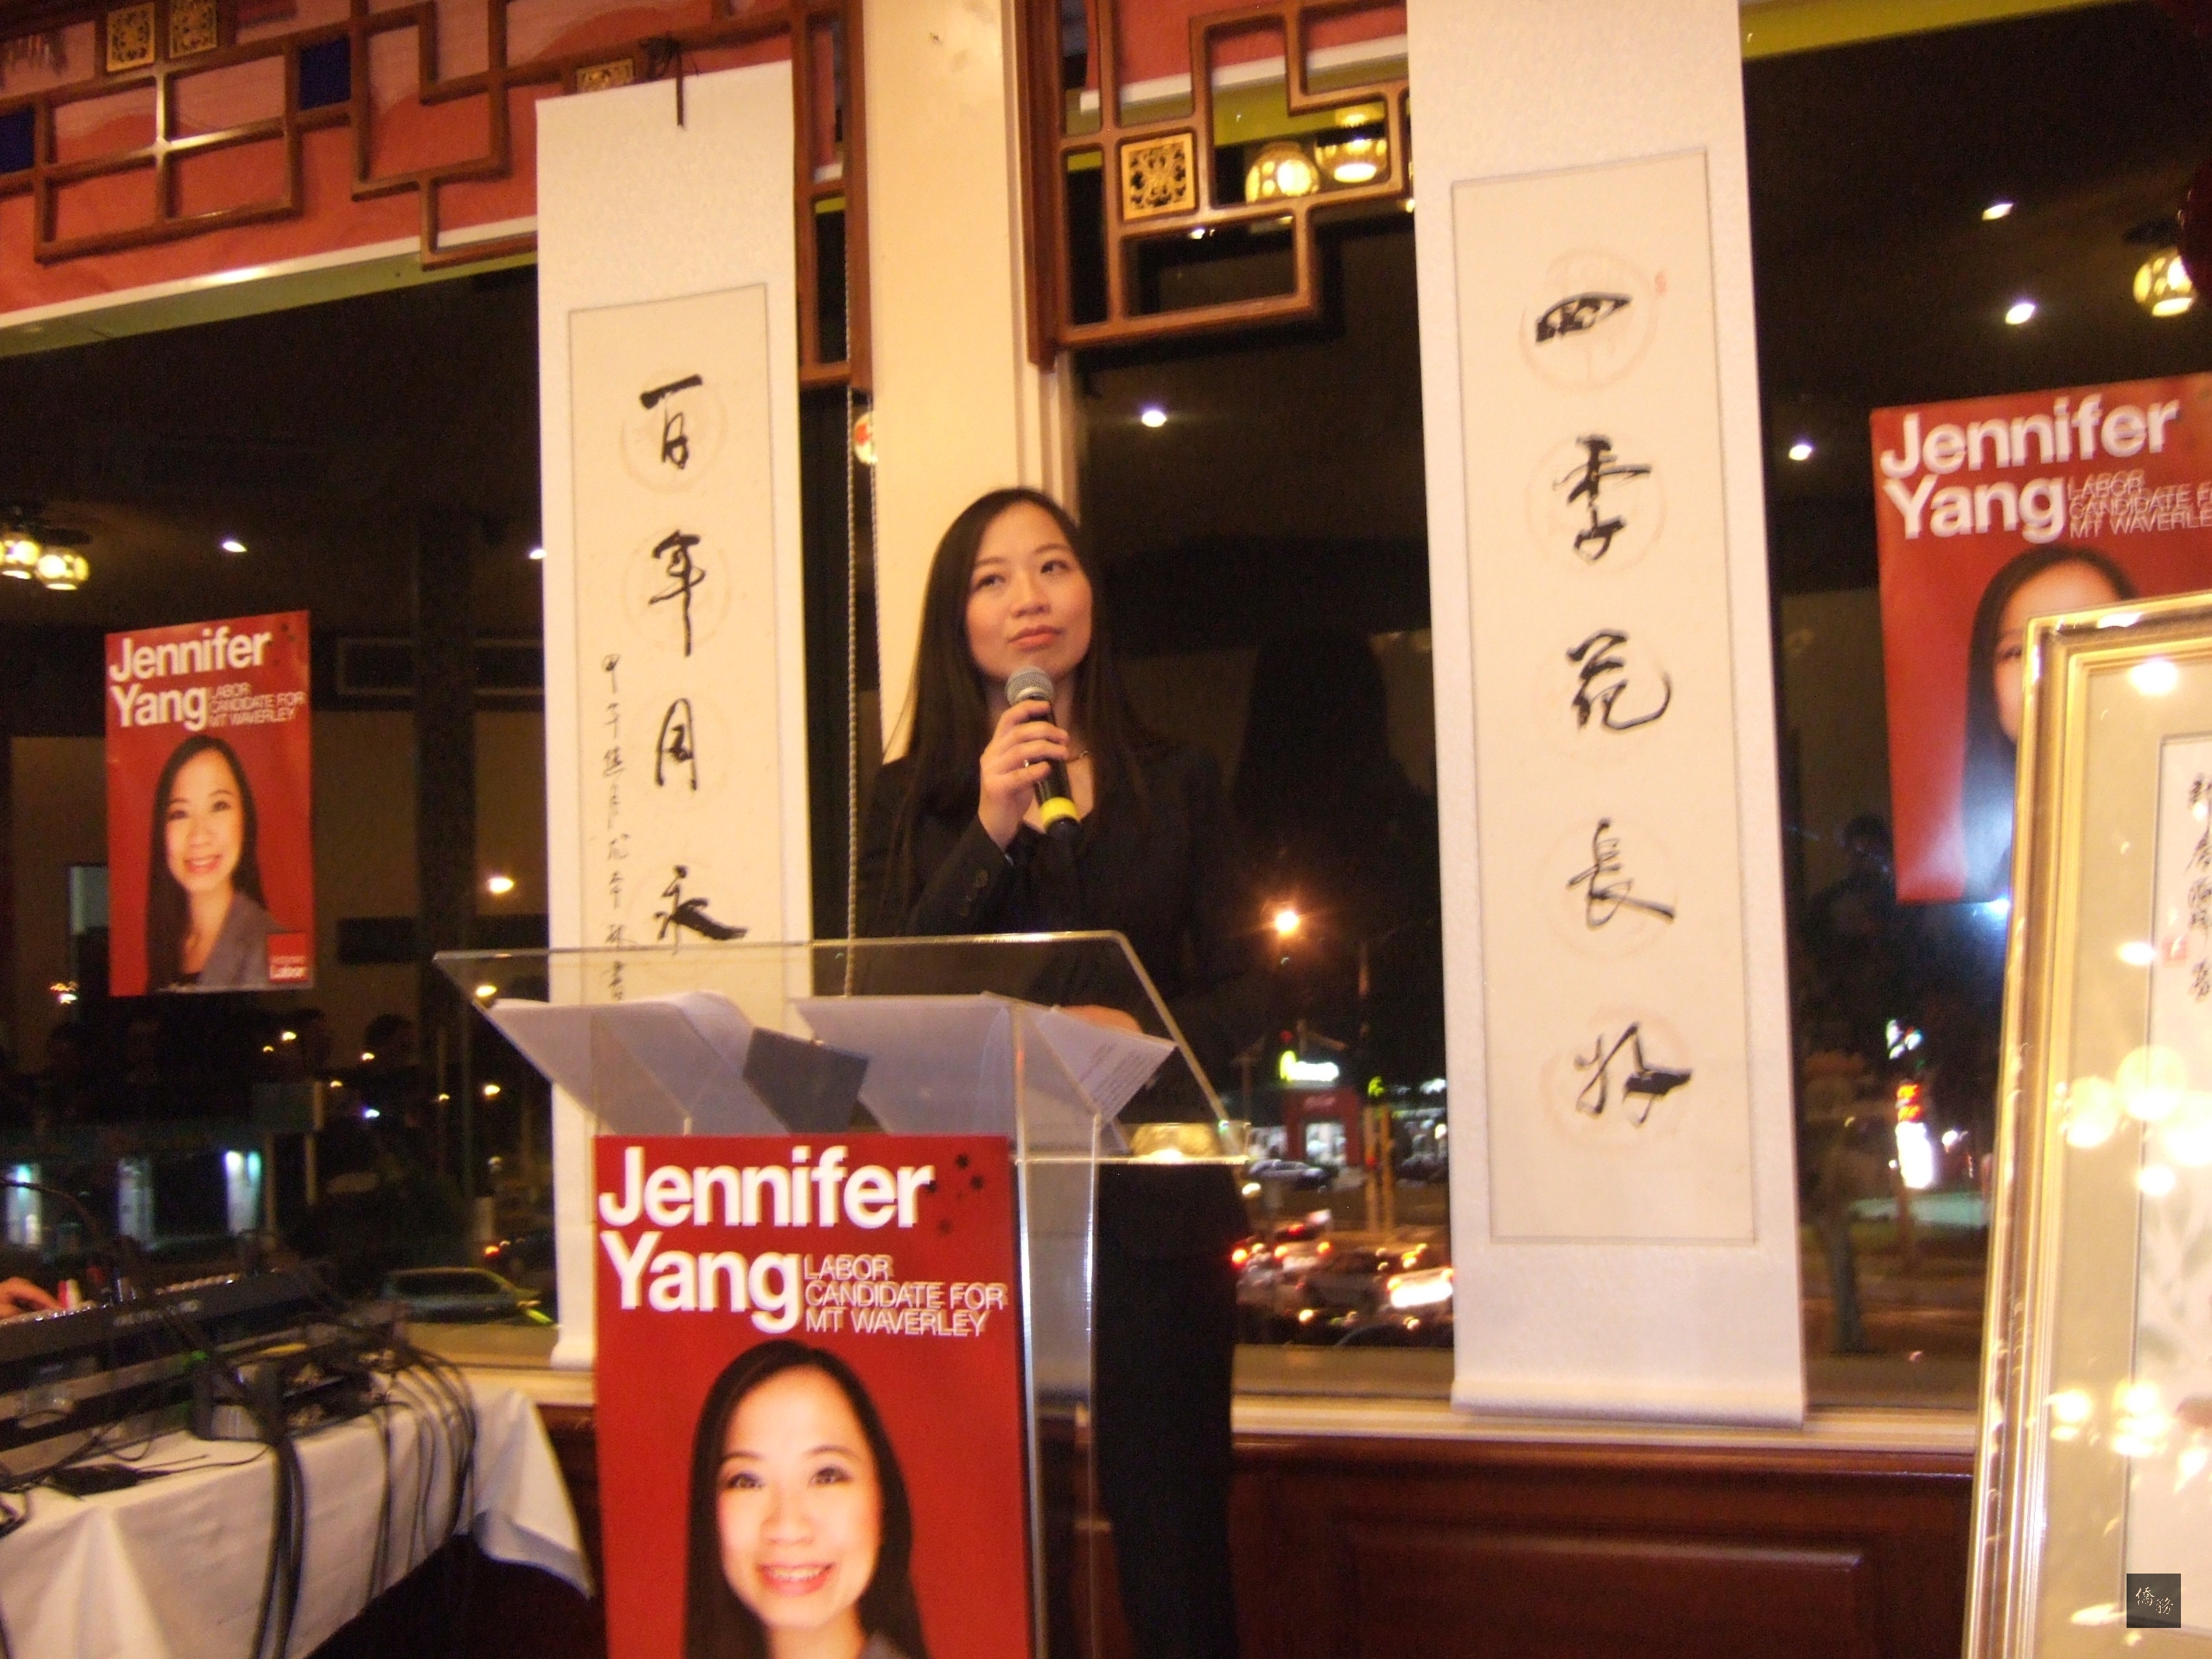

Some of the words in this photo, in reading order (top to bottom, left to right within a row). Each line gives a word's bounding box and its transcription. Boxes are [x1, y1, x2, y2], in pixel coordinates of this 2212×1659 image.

[1880, 393, 2180, 479] Jennifer
[2068, 469, 2145, 501] LABOR
[2070, 483, 2192, 520] CANDIDATE
[1883, 475, 2067, 544] Yang
[2109, 505, 2212, 535] WAVERLE
[110, 626, 272, 683] Jennifer
[111, 684, 208, 732] Yang
[277, 691, 308, 708] FOR
[598, 1146, 935, 1228] Jennifer
[600, 1231, 803, 1334] Yang
[804, 1254, 892, 1281] LABOR
[805, 1282, 945, 1309] CANDIDATE
[950, 1283, 1008, 1310] FOR
[806, 1308, 848, 1333] MT
[851, 1310, 989, 1337] WAVERLEY
